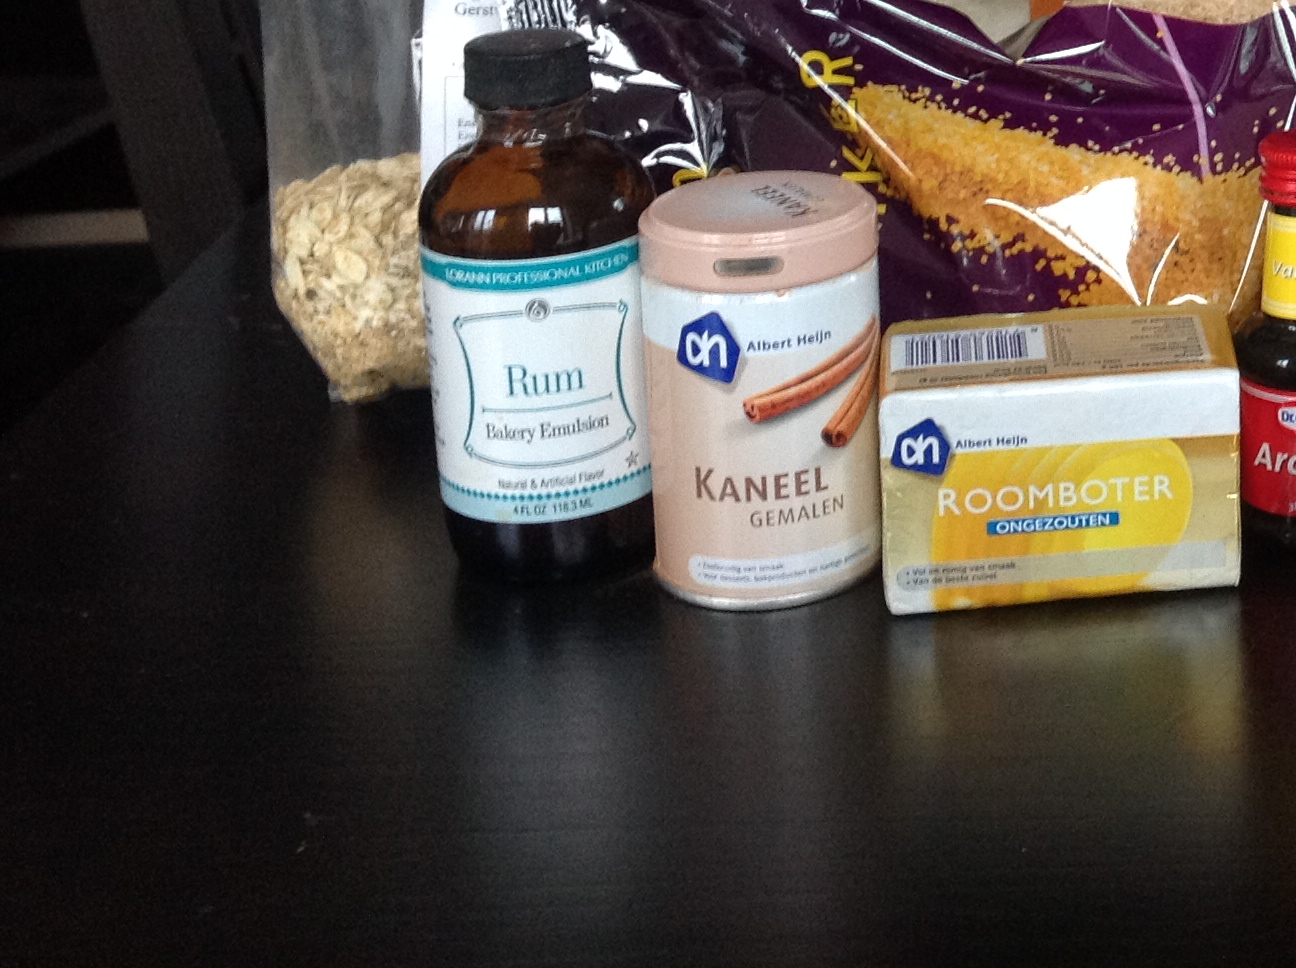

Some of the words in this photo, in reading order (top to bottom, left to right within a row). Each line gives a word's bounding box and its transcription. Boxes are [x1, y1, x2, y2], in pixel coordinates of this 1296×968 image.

[492, 264, 580, 285] PROFESSIONAL
[584, 252, 630, 275] KITCHEN
[746, 338, 792, 353] Albert
[797, 329, 832, 346] Heijn
[504, 364, 584, 398] Rum
[486, 421, 535, 444] Bakery
[540, 414, 609, 439] Emulsion
[955, 437, 992, 450] Albert
[997, 435, 1028, 447] Heijn
[530, 477, 538, 490] &
[578, 468, 605, 484] Flavor
[694, 465, 829, 504] KANEEL
[513, 504, 519, 515] 4
[520, 505, 532, 516] FL
[534, 503, 547, 516] OZ
[579, 496, 593, 509] ML
[937, 473, 1174, 517] ROOMBOTER
[750, 494, 844, 528] GEMALEN
[995, 513, 1111, 533] ONGEZOUTEN
